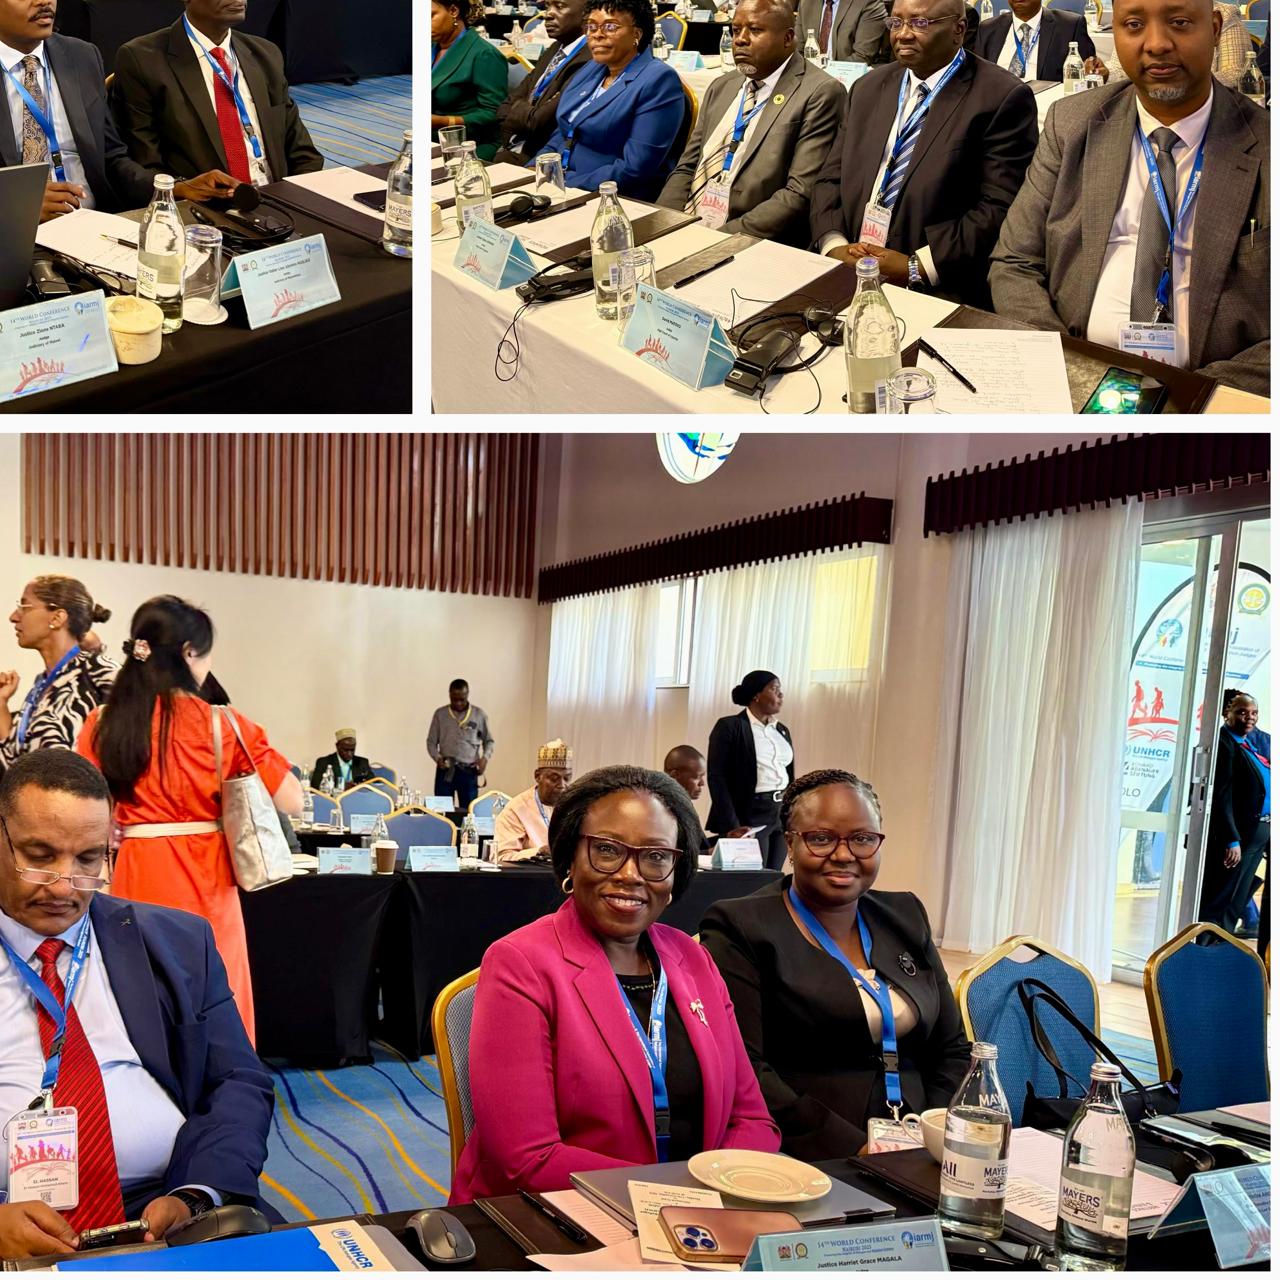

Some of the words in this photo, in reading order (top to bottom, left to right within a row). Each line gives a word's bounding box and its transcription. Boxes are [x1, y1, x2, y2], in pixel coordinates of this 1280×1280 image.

[1133, 746, 1170, 758] UNHCR
[1063, 1186, 1100, 1208] MAYERS
[831, 1239, 855, 1247] WORLD
[855, 1236, 896, 1245] CONFERENCE
[912, 1232, 934, 1242] iarmj
[343, 1239, 374, 1268] UNHCR
[877, 1255, 902, 1263] MAGALA
